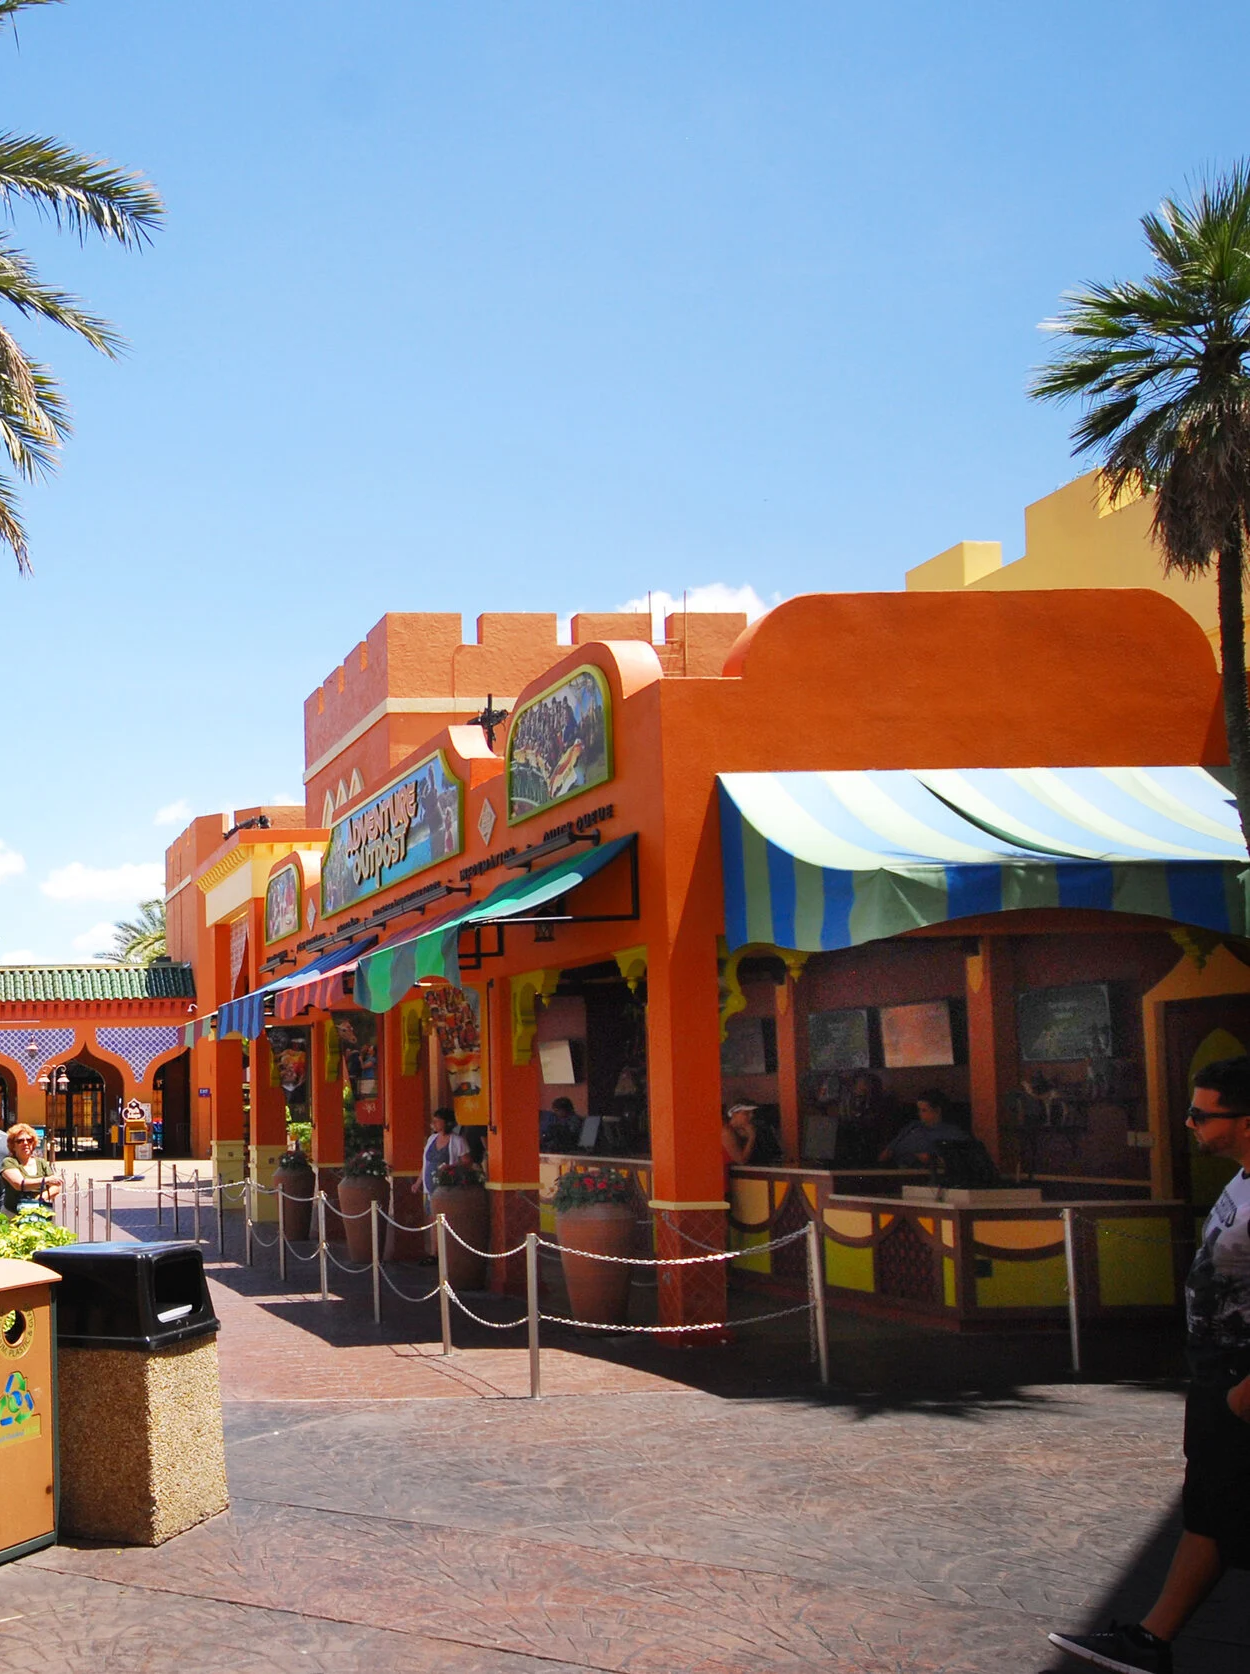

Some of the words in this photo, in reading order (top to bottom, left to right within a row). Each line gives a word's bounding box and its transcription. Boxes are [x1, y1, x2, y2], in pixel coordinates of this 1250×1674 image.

[347, 780, 418, 857] ADVENTURE
[575, 803, 614, 832] QUEUE
[352, 824, 408, 888] OUTPOST
[8, 1338, 31, 1358] PLASTIC
